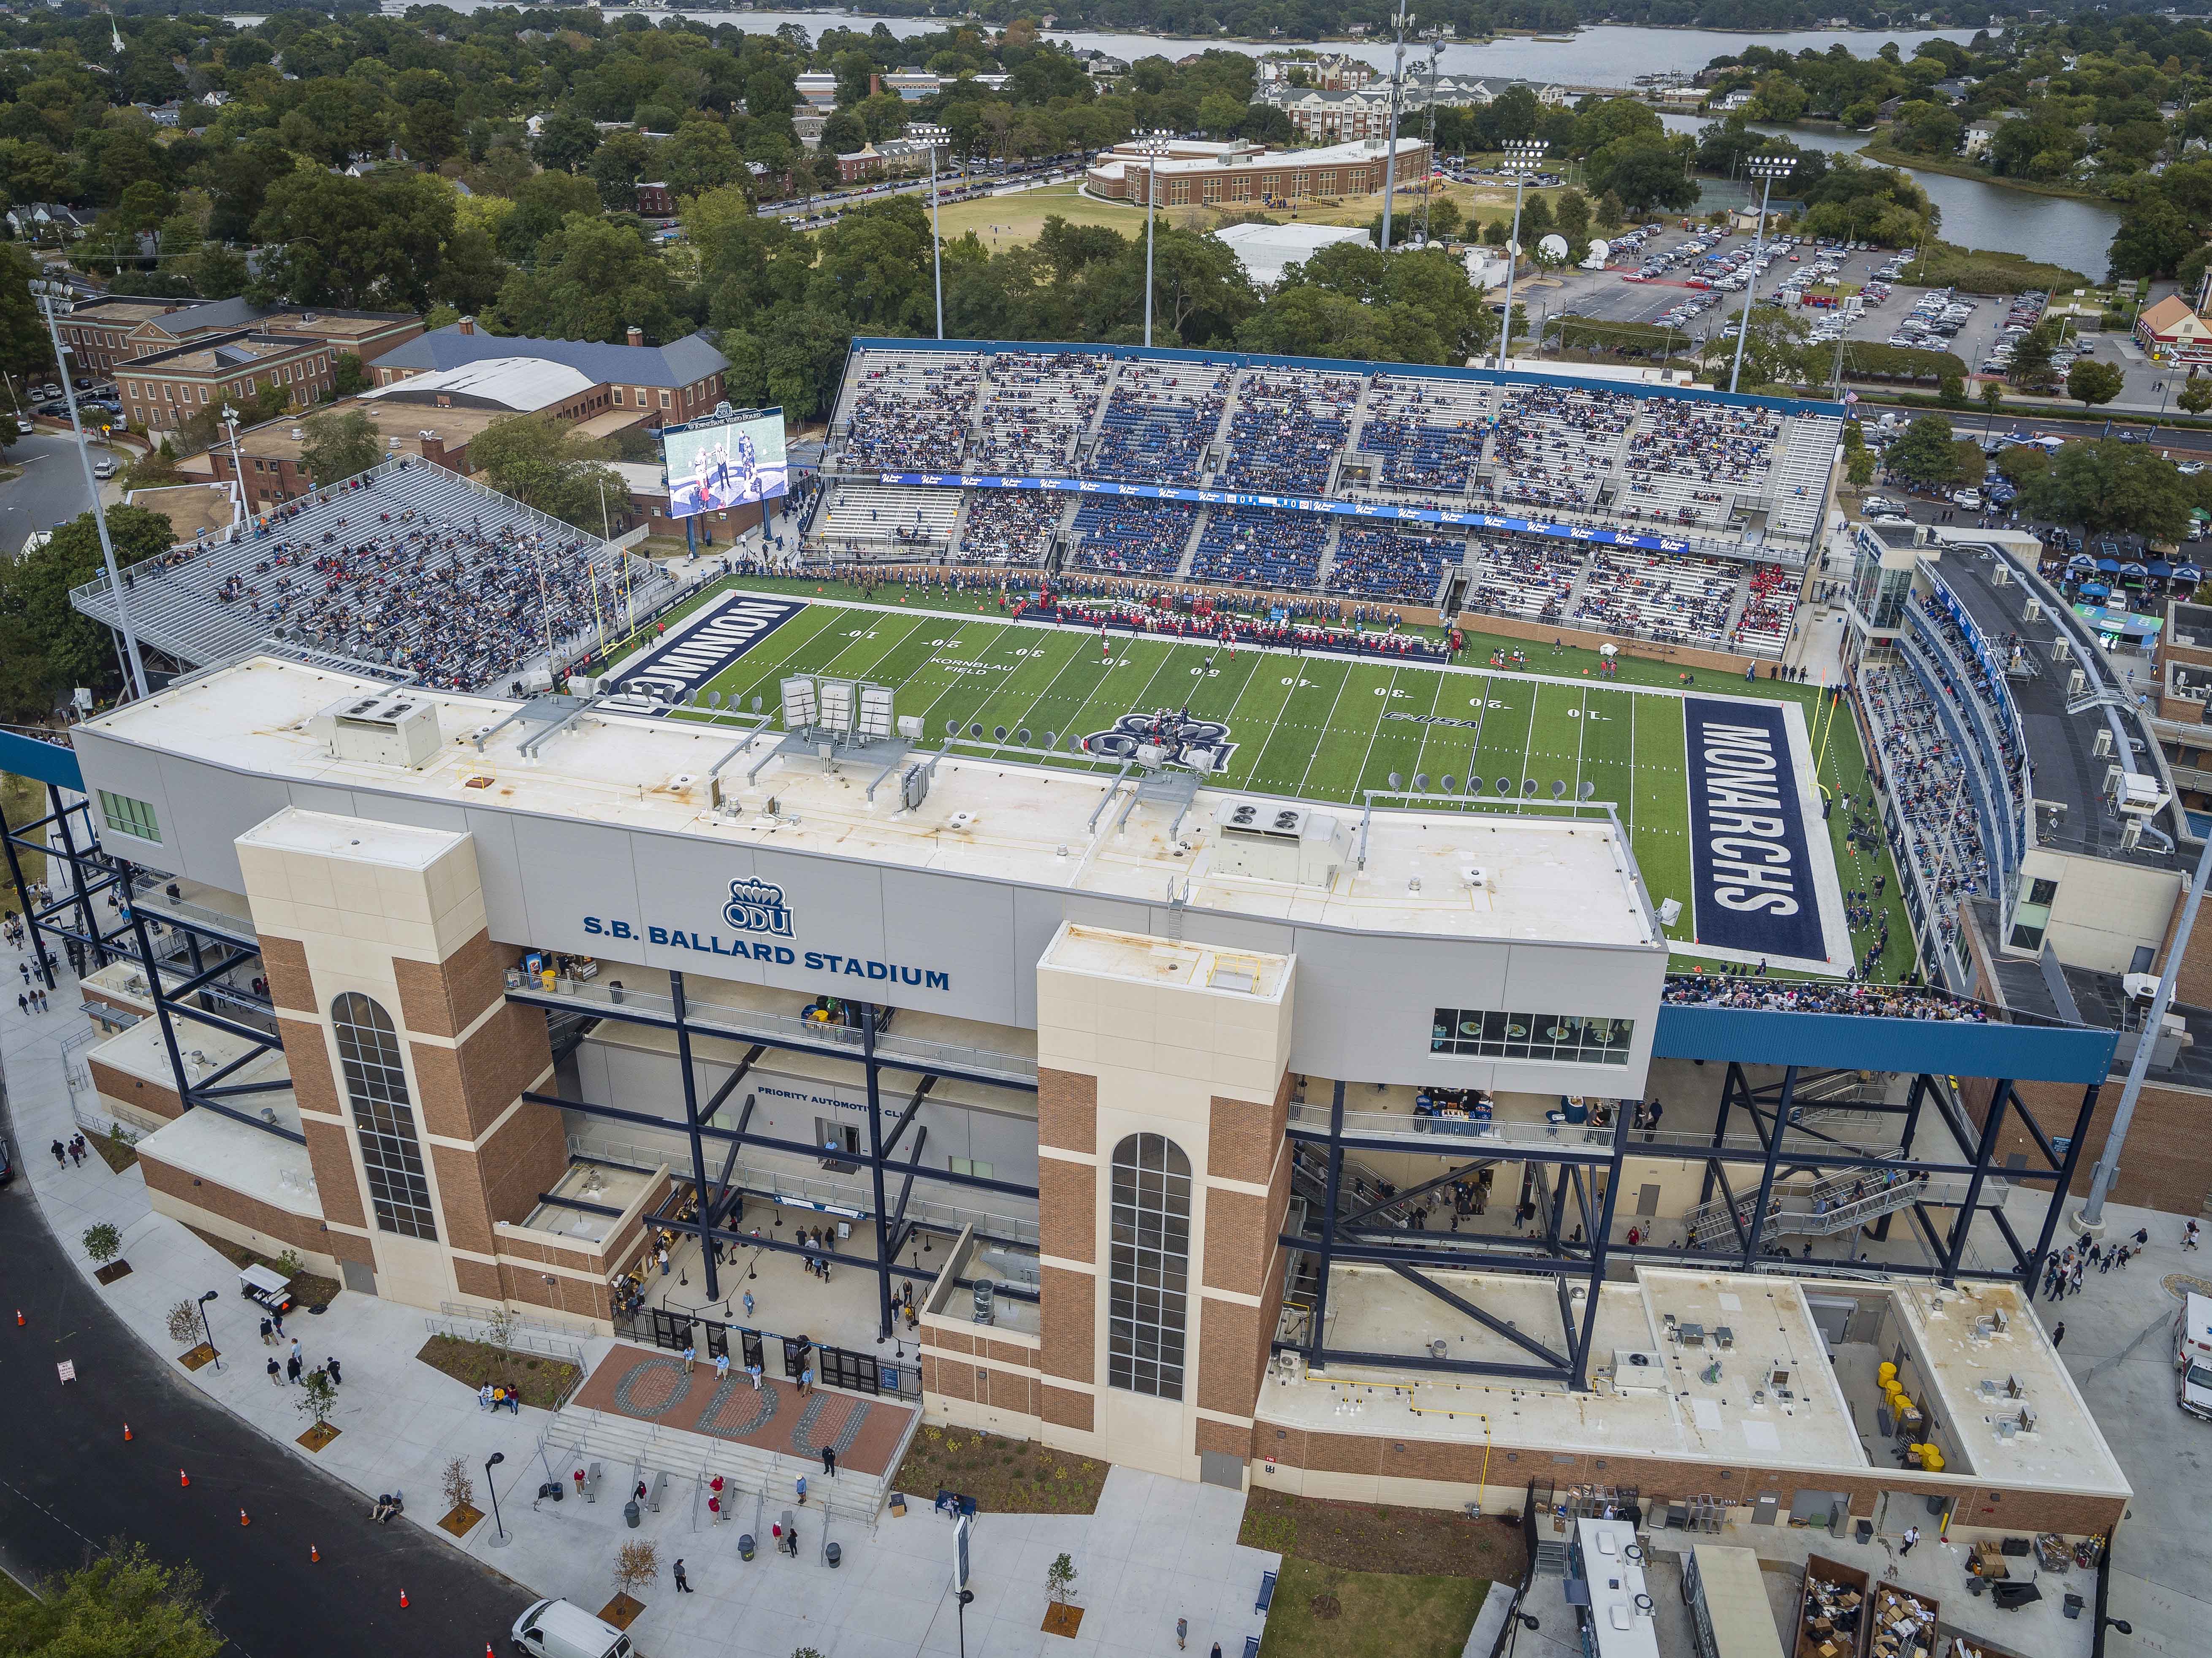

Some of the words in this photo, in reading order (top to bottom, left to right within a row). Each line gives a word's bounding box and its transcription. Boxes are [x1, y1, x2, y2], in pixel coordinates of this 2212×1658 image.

[717, 409, 731, 417] ODU
[661, 602, 674, 614] Atlantic
[675, 595, 685, 604] Union
[686, 589, 694, 598] Bank
[2083, 607, 2097, 616] COX
[2137, 617, 2152, 626] COX
[2101, 632, 2120, 640] COX
[590, 649, 602, 659] TOYOTA
[594, 601, 791, 714] DOMINION
[930, 657, 1014, 672] KORNBLAU
[944, 666, 987, 675] FIELD
[1702, 722, 1799, 915] MONARCHS
[720, 901, 796, 940] ODU
[583, 915, 640, 941] S.B.
[649, 925, 795, 965] BALLARD
[804, 951, 950, 992] STADIUM
[757, 1086, 808, 1103] PRIORITY
[811, 1096, 881, 1115] AUTOMOTI
[614, 1357, 873, 1458] ODU
